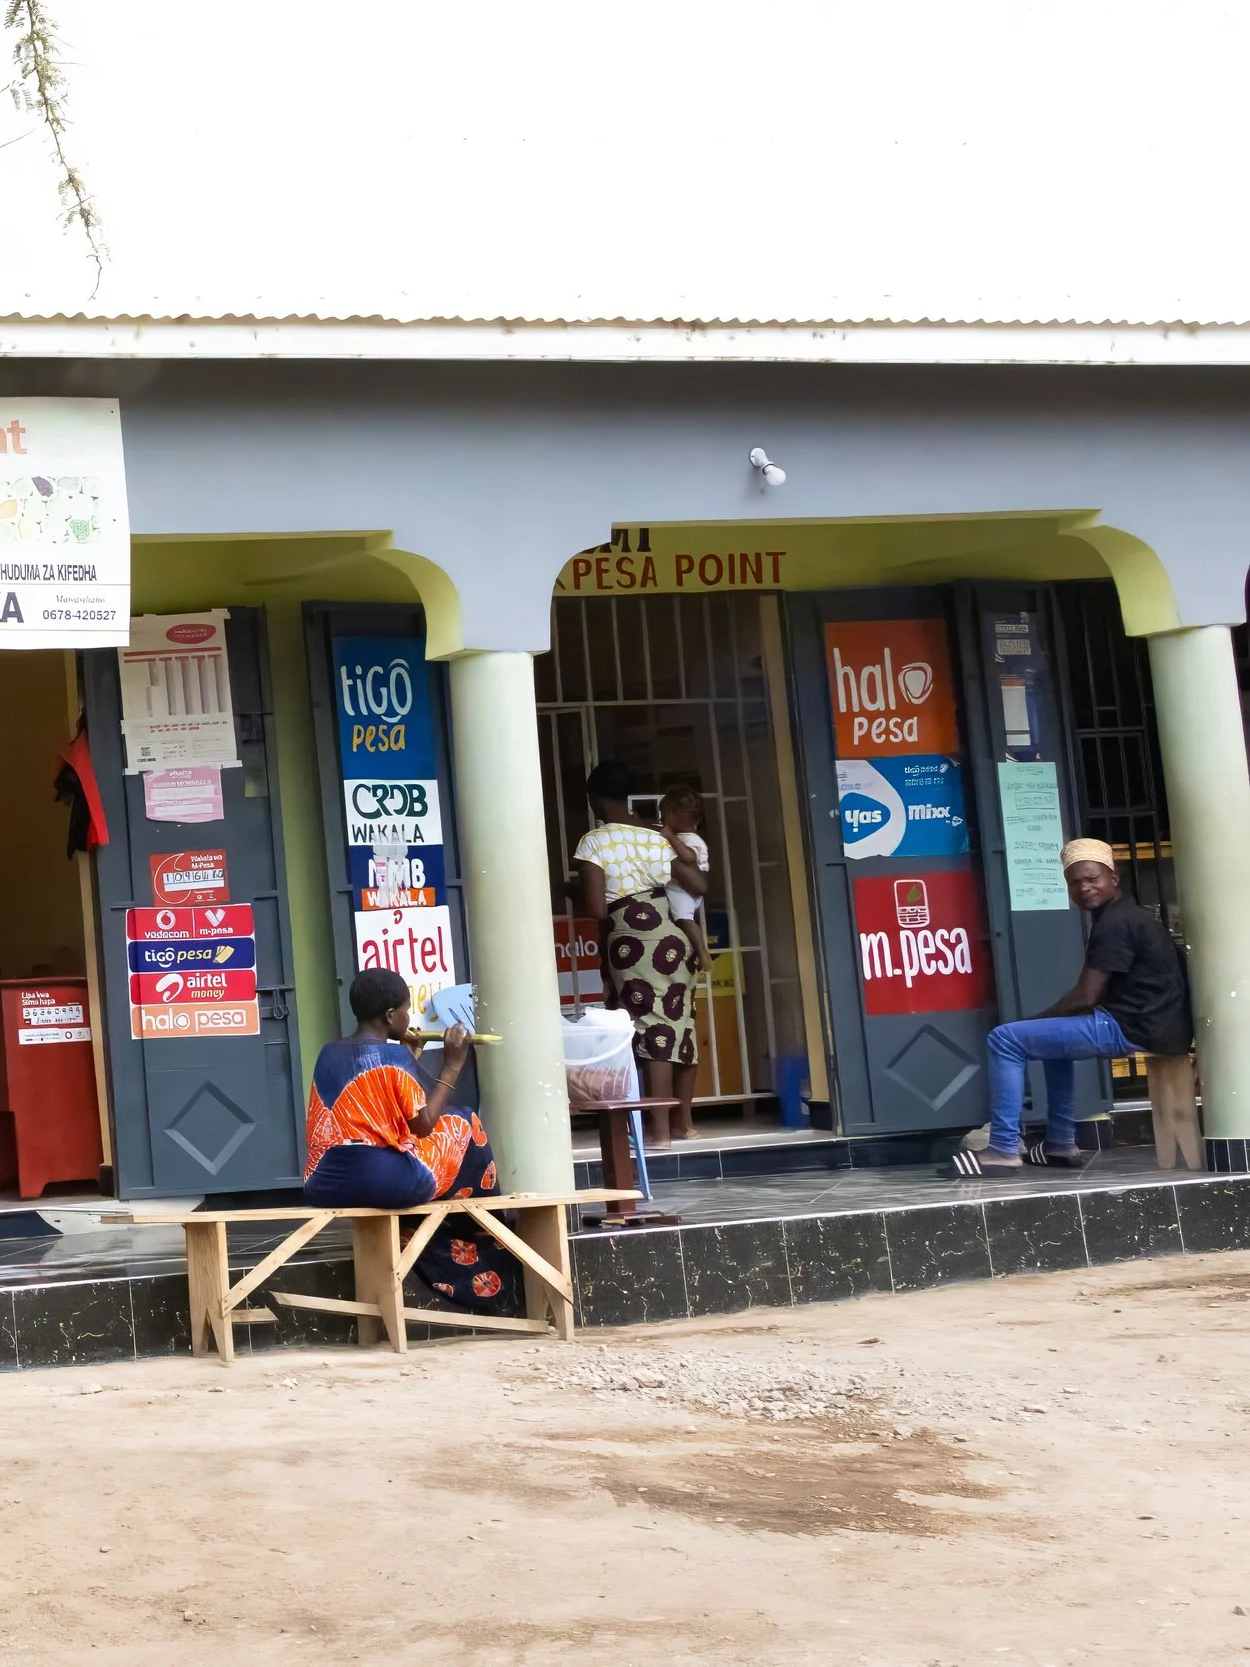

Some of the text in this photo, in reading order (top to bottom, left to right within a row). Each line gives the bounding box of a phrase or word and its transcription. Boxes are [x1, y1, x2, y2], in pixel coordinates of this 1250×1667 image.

[0, 563, 97, 582] HUDUMA ZA KIFEDHA
[675, 551, 787, 587] POINT
[42, 609, 117, 621] 0678-420527
[833, 647, 934, 713] halo
[340, 658, 413, 724] tigo
[352, 724, 406, 753] pesa
[853, 715, 918, 746] pesa
[352, 783, 429, 820] CRDB
[352, 823, 425, 843] WAKALA
[367, 889, 427, 907] WKALA
[144, 930, 190, 939] vodacom
[199, 926, 234, 936] m-pesa
[144, 947, 212, 968] tigo pesa
[362, 926, 448, 975] airtel
[186, 973, 228, 988] airtel
[190, 988, 225, 1000] money
[141, 1008, 246, 1033] halo pesa
